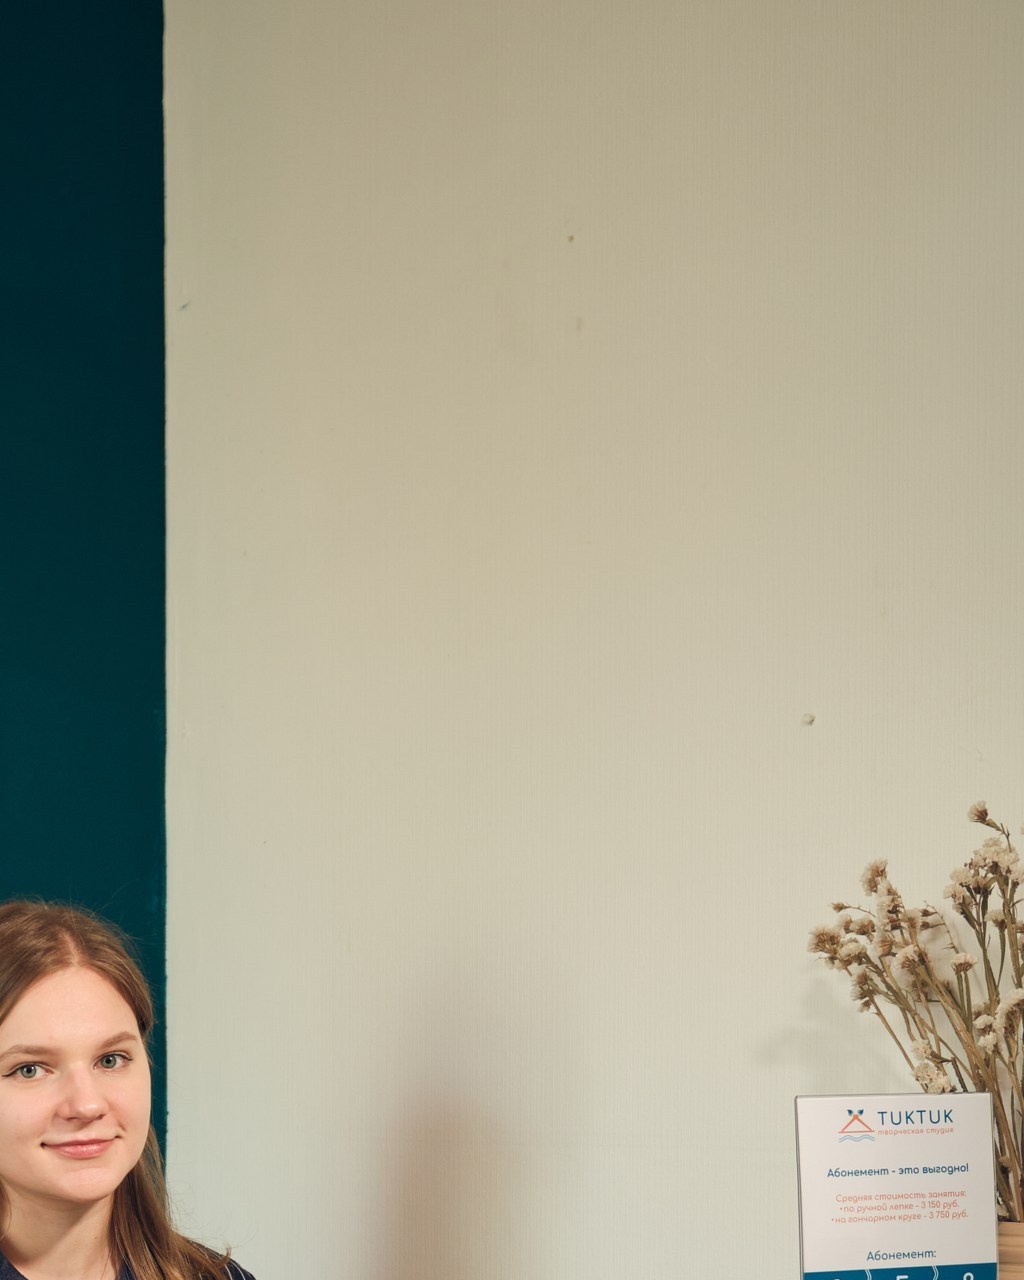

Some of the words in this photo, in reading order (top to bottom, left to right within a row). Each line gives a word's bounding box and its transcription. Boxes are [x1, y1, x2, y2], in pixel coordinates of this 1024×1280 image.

[877, 1109, 953, 1125] TUKTUK
[878, 1128, 924, 1136] творческая
[926, 1127, 953, 1135] студия
[827, 1168, 889, 1178] Абонемент
[898, 1167, 919, 1175] это
[922, 1163, 969, 1176] выгодно!
[836, 1194, 872, 1204] Средняя
[875, 1191, 926, 1201] стоимость
[928, 1190, 966, 1199] занятия:
[857, 1202, 887, 1214] ручной
[889, 1203, 913, 1211] лепке
[927, 1201, 940, 1209] 150
[942, 1200, 959, 1210] руб.
[848, 1215, 896, 1224] гончарном
[898, 1213, 921, 1222] круге
[936, 1211, 950, 1219] 750
[952, 1210, 969, 1220] руб.
[867, 1250, 937, 1261] Абонемент:
